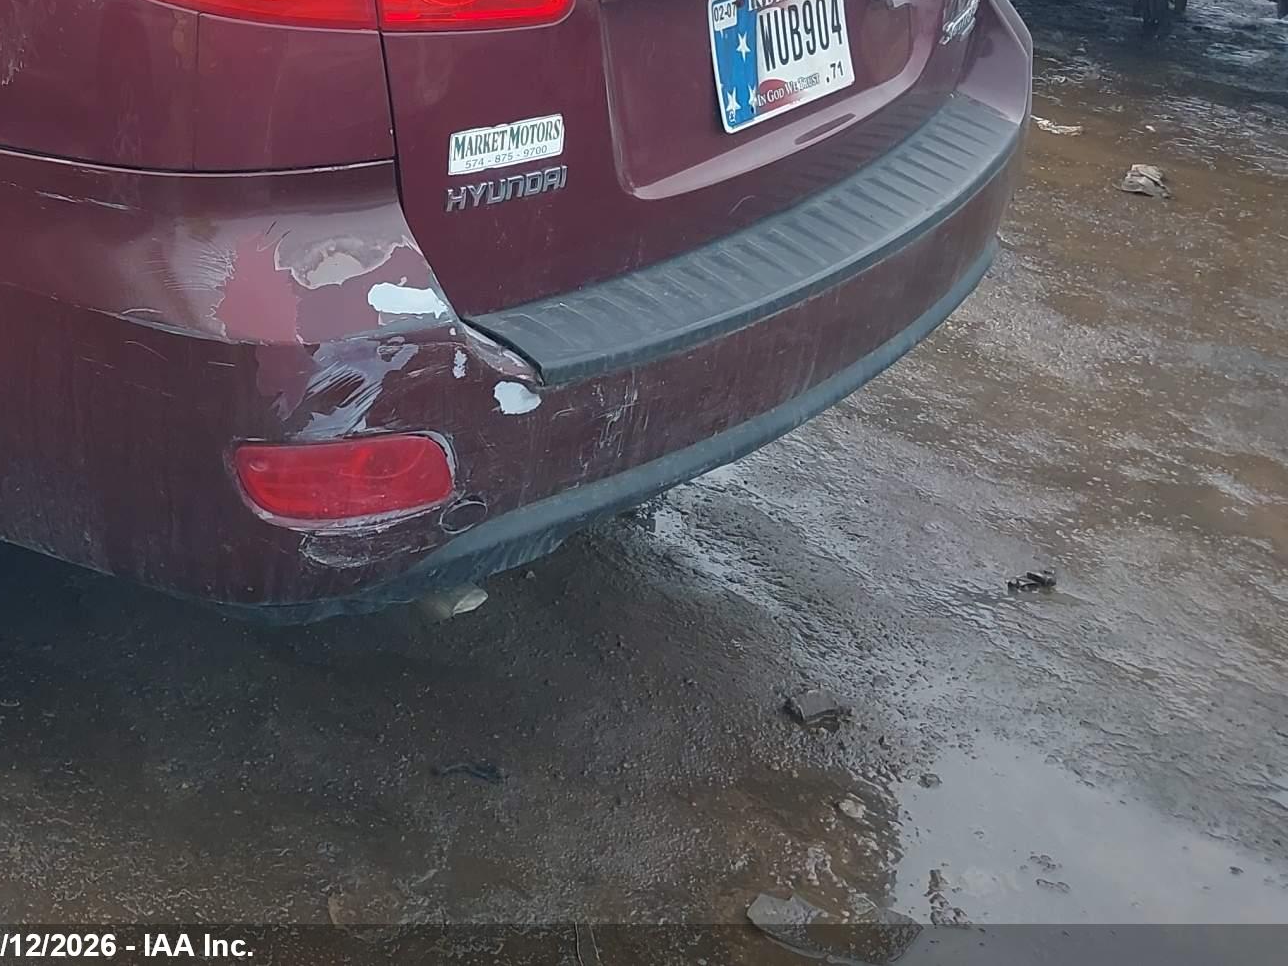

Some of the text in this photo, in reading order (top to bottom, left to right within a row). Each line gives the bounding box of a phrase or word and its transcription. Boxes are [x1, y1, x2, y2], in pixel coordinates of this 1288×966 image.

[713, 1, 737, 22] 02-07
[767, 87, 784, 104] GOD
[798, 74, 820, 90] TRUST
[453, 119, 561, 161] MARKET MOTORS
[447, 166, 568, 211] HYUNDAI
